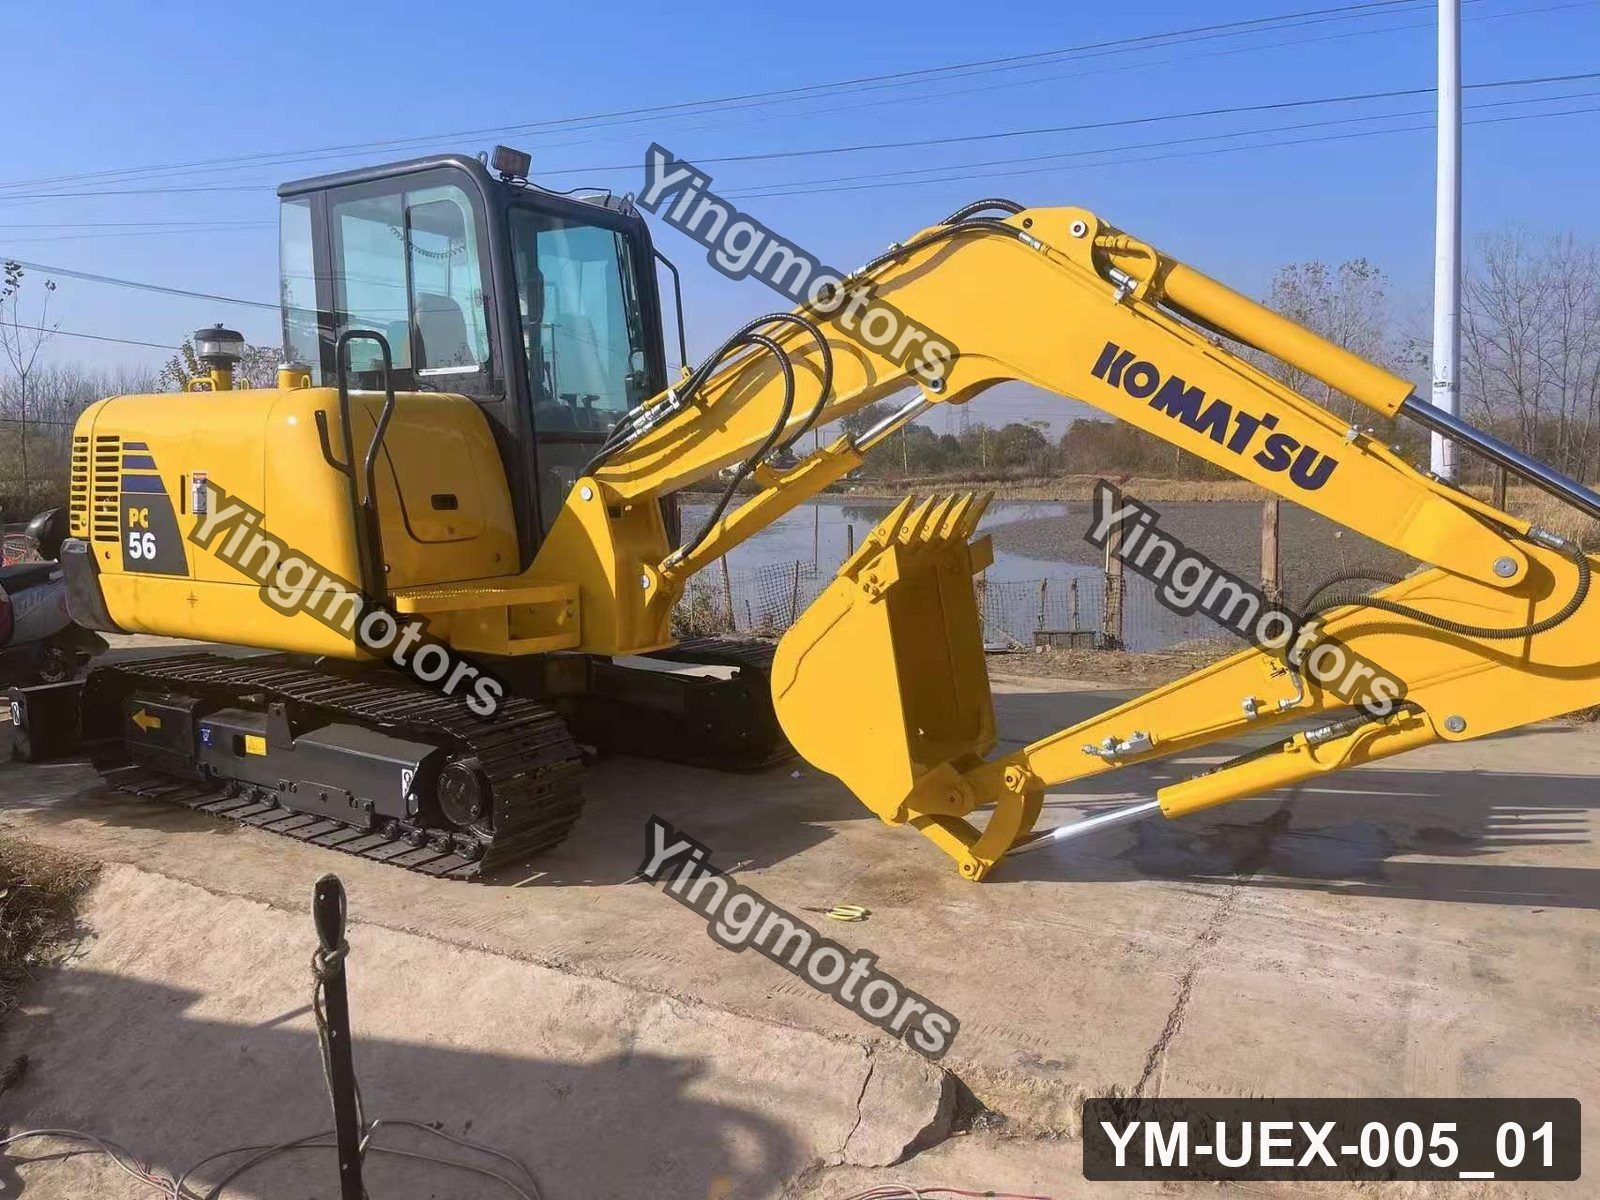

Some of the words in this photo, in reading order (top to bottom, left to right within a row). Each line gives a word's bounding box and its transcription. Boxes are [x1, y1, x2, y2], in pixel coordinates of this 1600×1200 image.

[1090, 341, 1339, 490] KOMATSU
[128, 507, 149, 529] PC
[129, 532, 157, 560] 56
